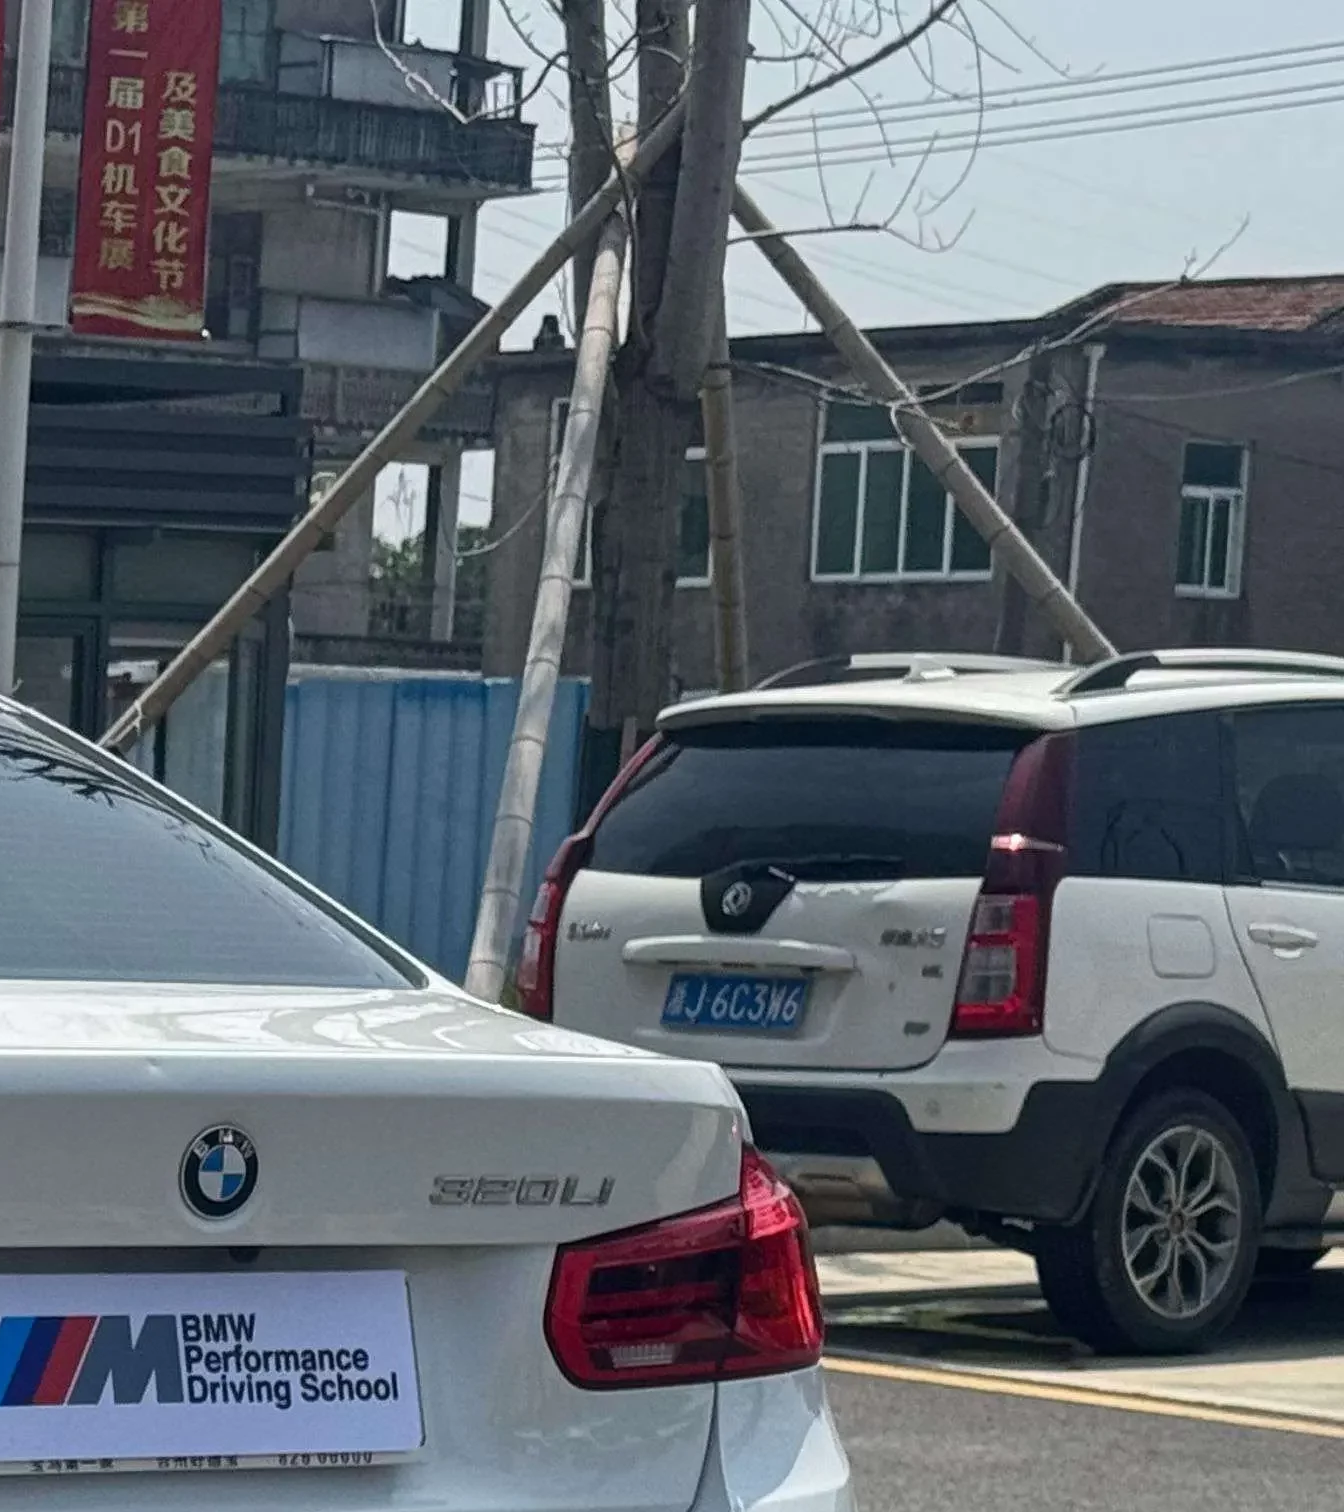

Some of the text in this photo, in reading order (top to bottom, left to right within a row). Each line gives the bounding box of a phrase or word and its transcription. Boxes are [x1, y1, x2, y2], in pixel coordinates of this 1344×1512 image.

[149, 70, 197, 290] 及美食文化节
[181, 1313, 256, 1343] BMW
[184, 1344, 369, 1374] Performance
[187, 1371, 399, 1410] Driving School
